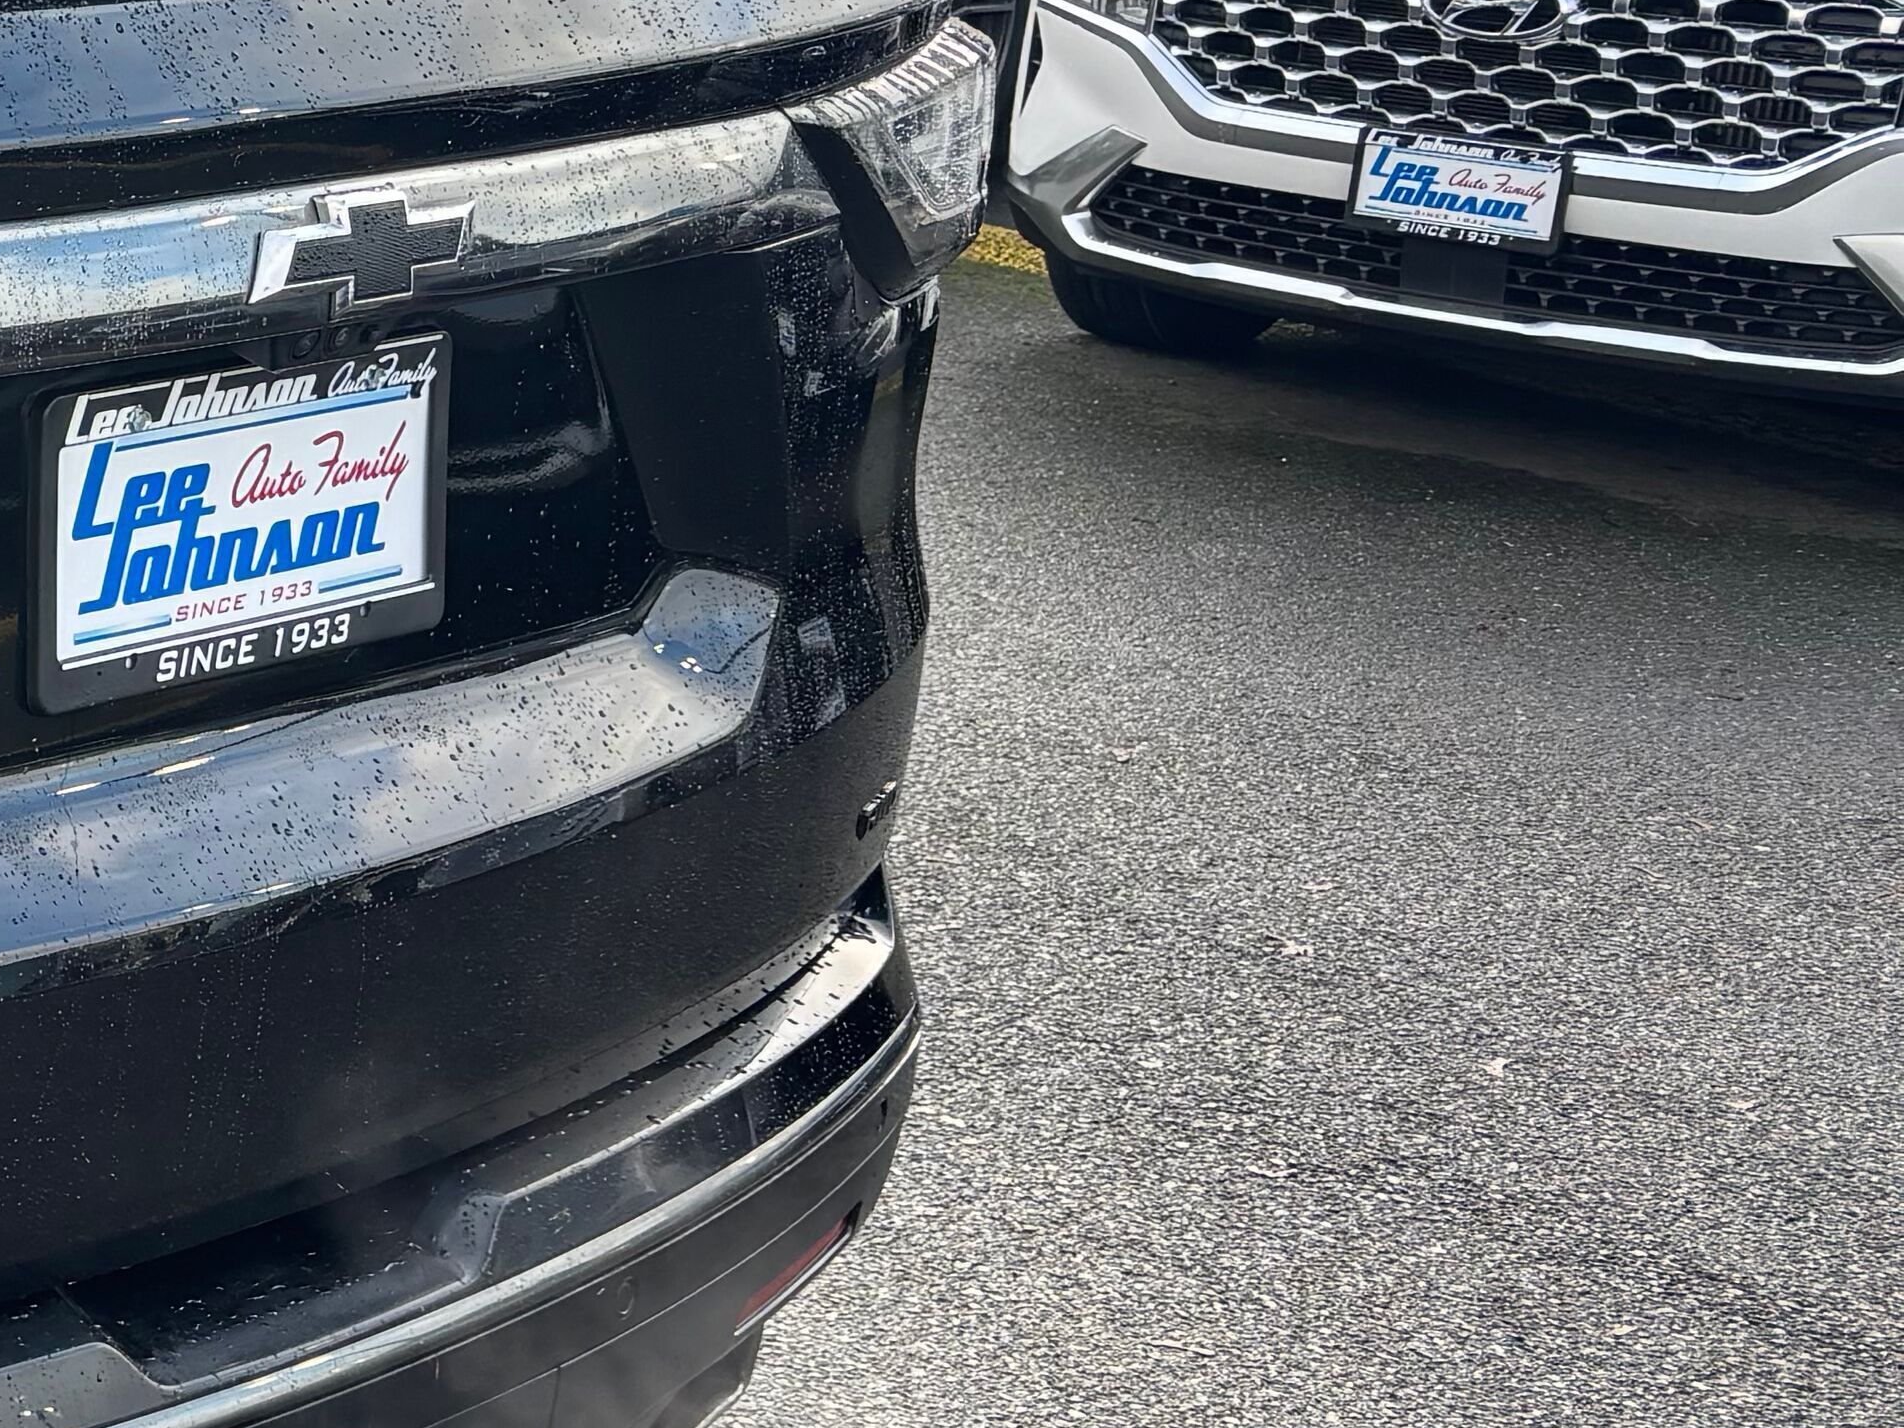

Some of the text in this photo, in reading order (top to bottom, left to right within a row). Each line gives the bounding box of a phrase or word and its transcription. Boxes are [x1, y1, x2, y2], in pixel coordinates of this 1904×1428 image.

[1369, 145, 1440, 180] Lee
[1407, 134, 1494, 160] Johnson
[1368, 178, 1528, 222] Johnson
[1449, 169, 1546, 205] Auto Family
[1397, 221, 1501, 245] SINCE 1933
[65, 394, 140, 445] Lee
[148, 373, 318, 429] Johnson
[376, 348, 437, 400] Family
[232, 421, 408, 508] Auto Family
[72, 442, 211, 541] Lee
[78, 499, 385, 614] Johnson
[175, 580, 313, 622] SINCE 1933
[156, 613, 350, 683] SINCE 1933
